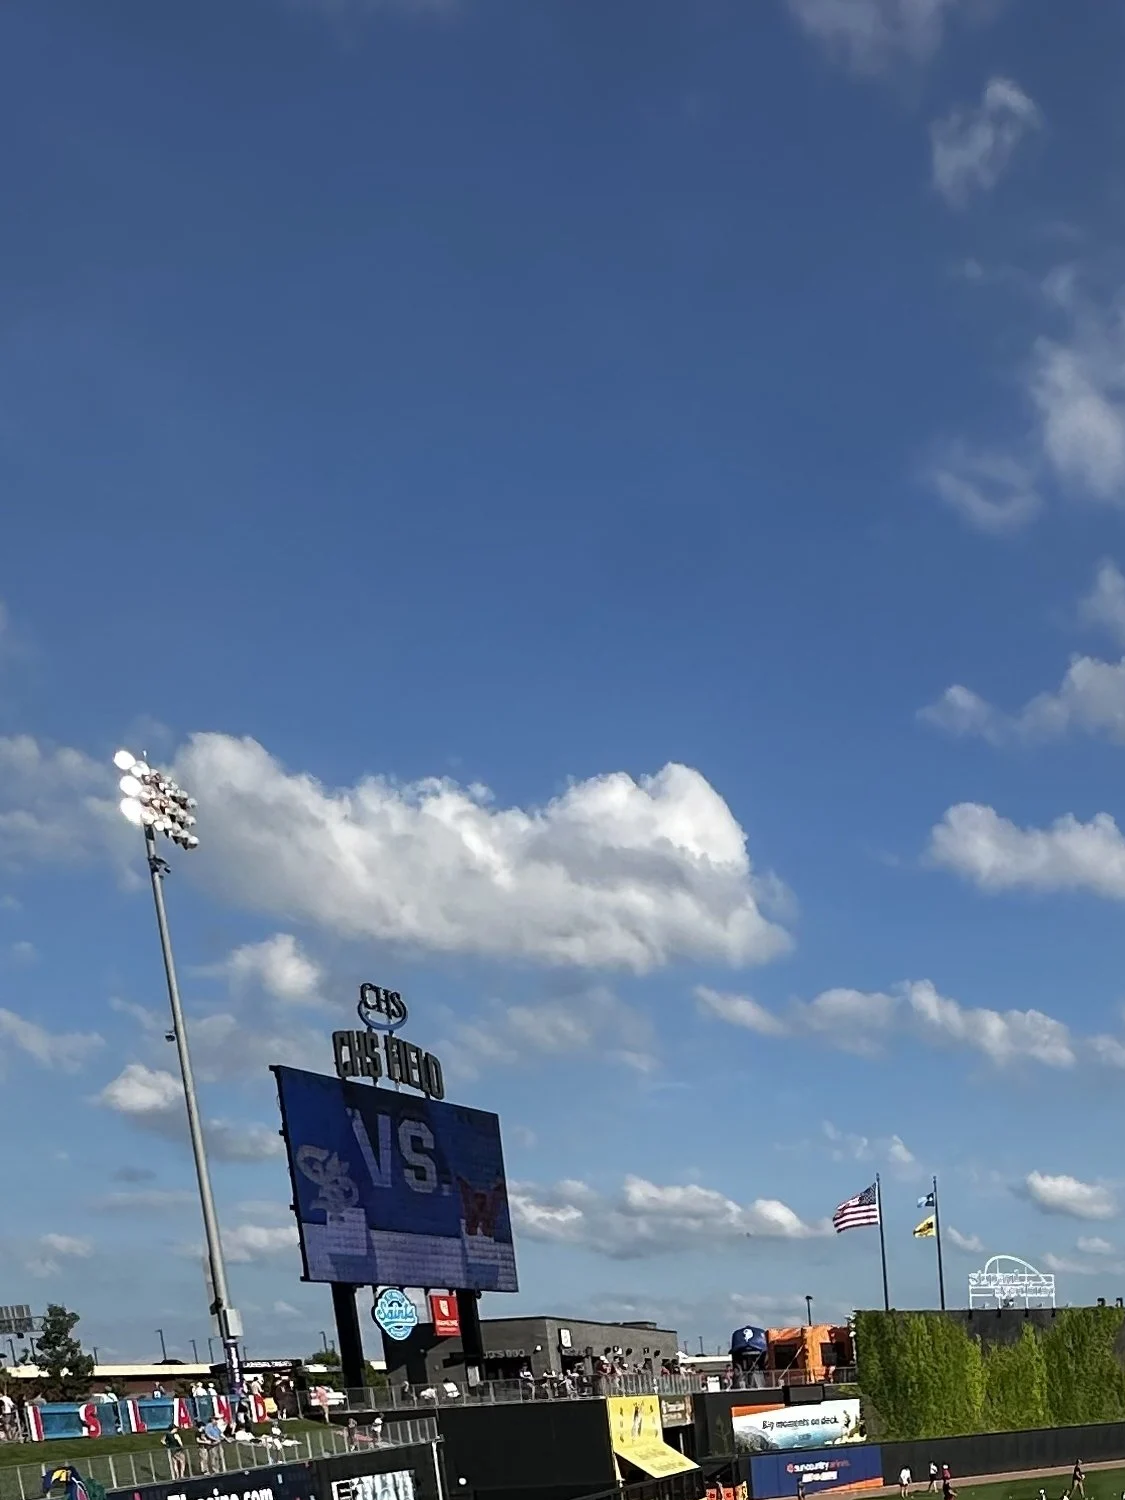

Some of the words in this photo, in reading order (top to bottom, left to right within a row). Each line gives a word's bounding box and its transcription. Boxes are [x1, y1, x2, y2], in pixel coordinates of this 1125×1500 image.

[360, 982, 403, 1019] CHS
[332, 1030, 383, 1078] CHS
[384, 1034, 445, 1100] FIELD
